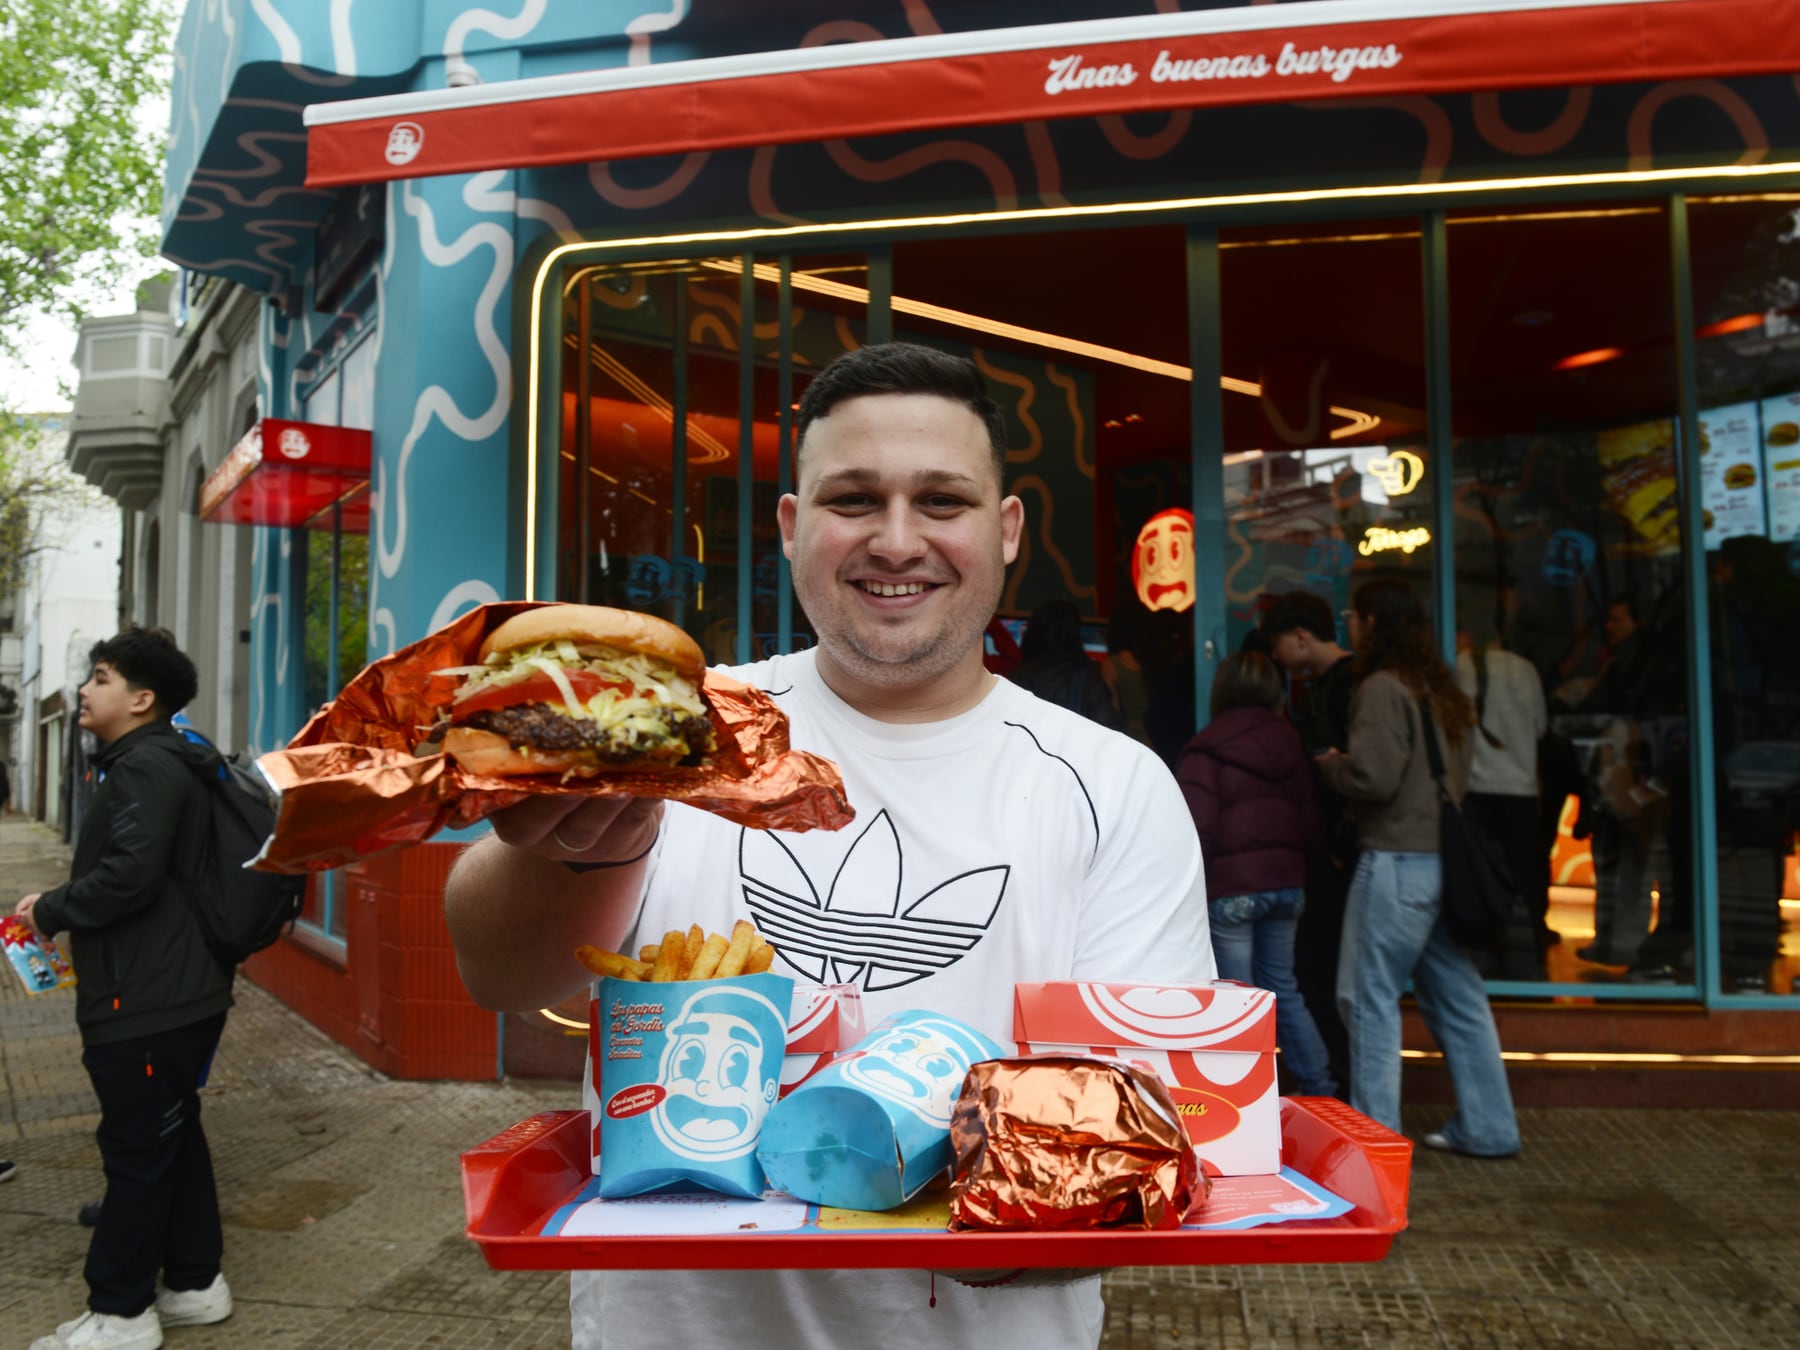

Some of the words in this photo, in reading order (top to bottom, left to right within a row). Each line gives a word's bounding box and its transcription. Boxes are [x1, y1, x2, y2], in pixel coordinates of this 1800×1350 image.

[1044, 54, 1138, 95] Unas
[1149, 50, 1272, 82] buenas
[1275, 42, 1403, 82] burgas
[624, 1003, 664, 1018] papas
